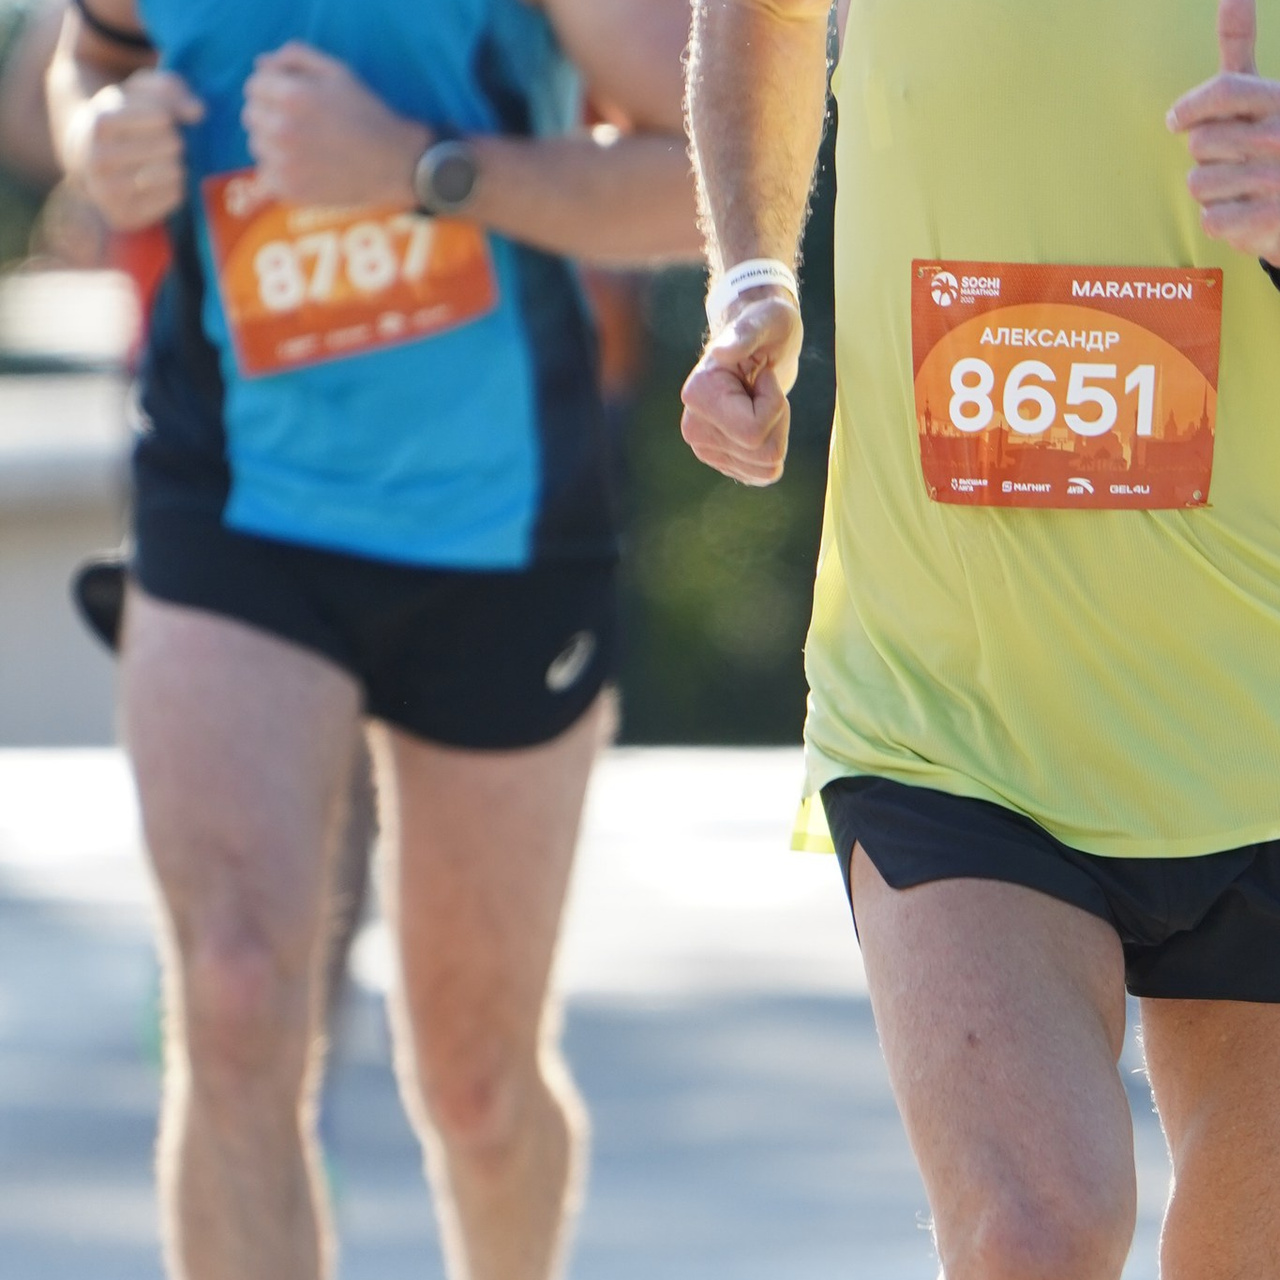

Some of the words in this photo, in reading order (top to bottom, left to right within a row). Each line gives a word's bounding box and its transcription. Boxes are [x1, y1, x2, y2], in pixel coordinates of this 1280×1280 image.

[253, 214, 436, 313] 8787
[961, 276, 1001, 289] SOCHI
[961, 287, 1001, 297] MARATHON
[1071, 279, 1193, 300] MARATHON
[979, 327, 1120, 352] АЛЕКСАНДР
[948, 357, 1156, 437] 8651
